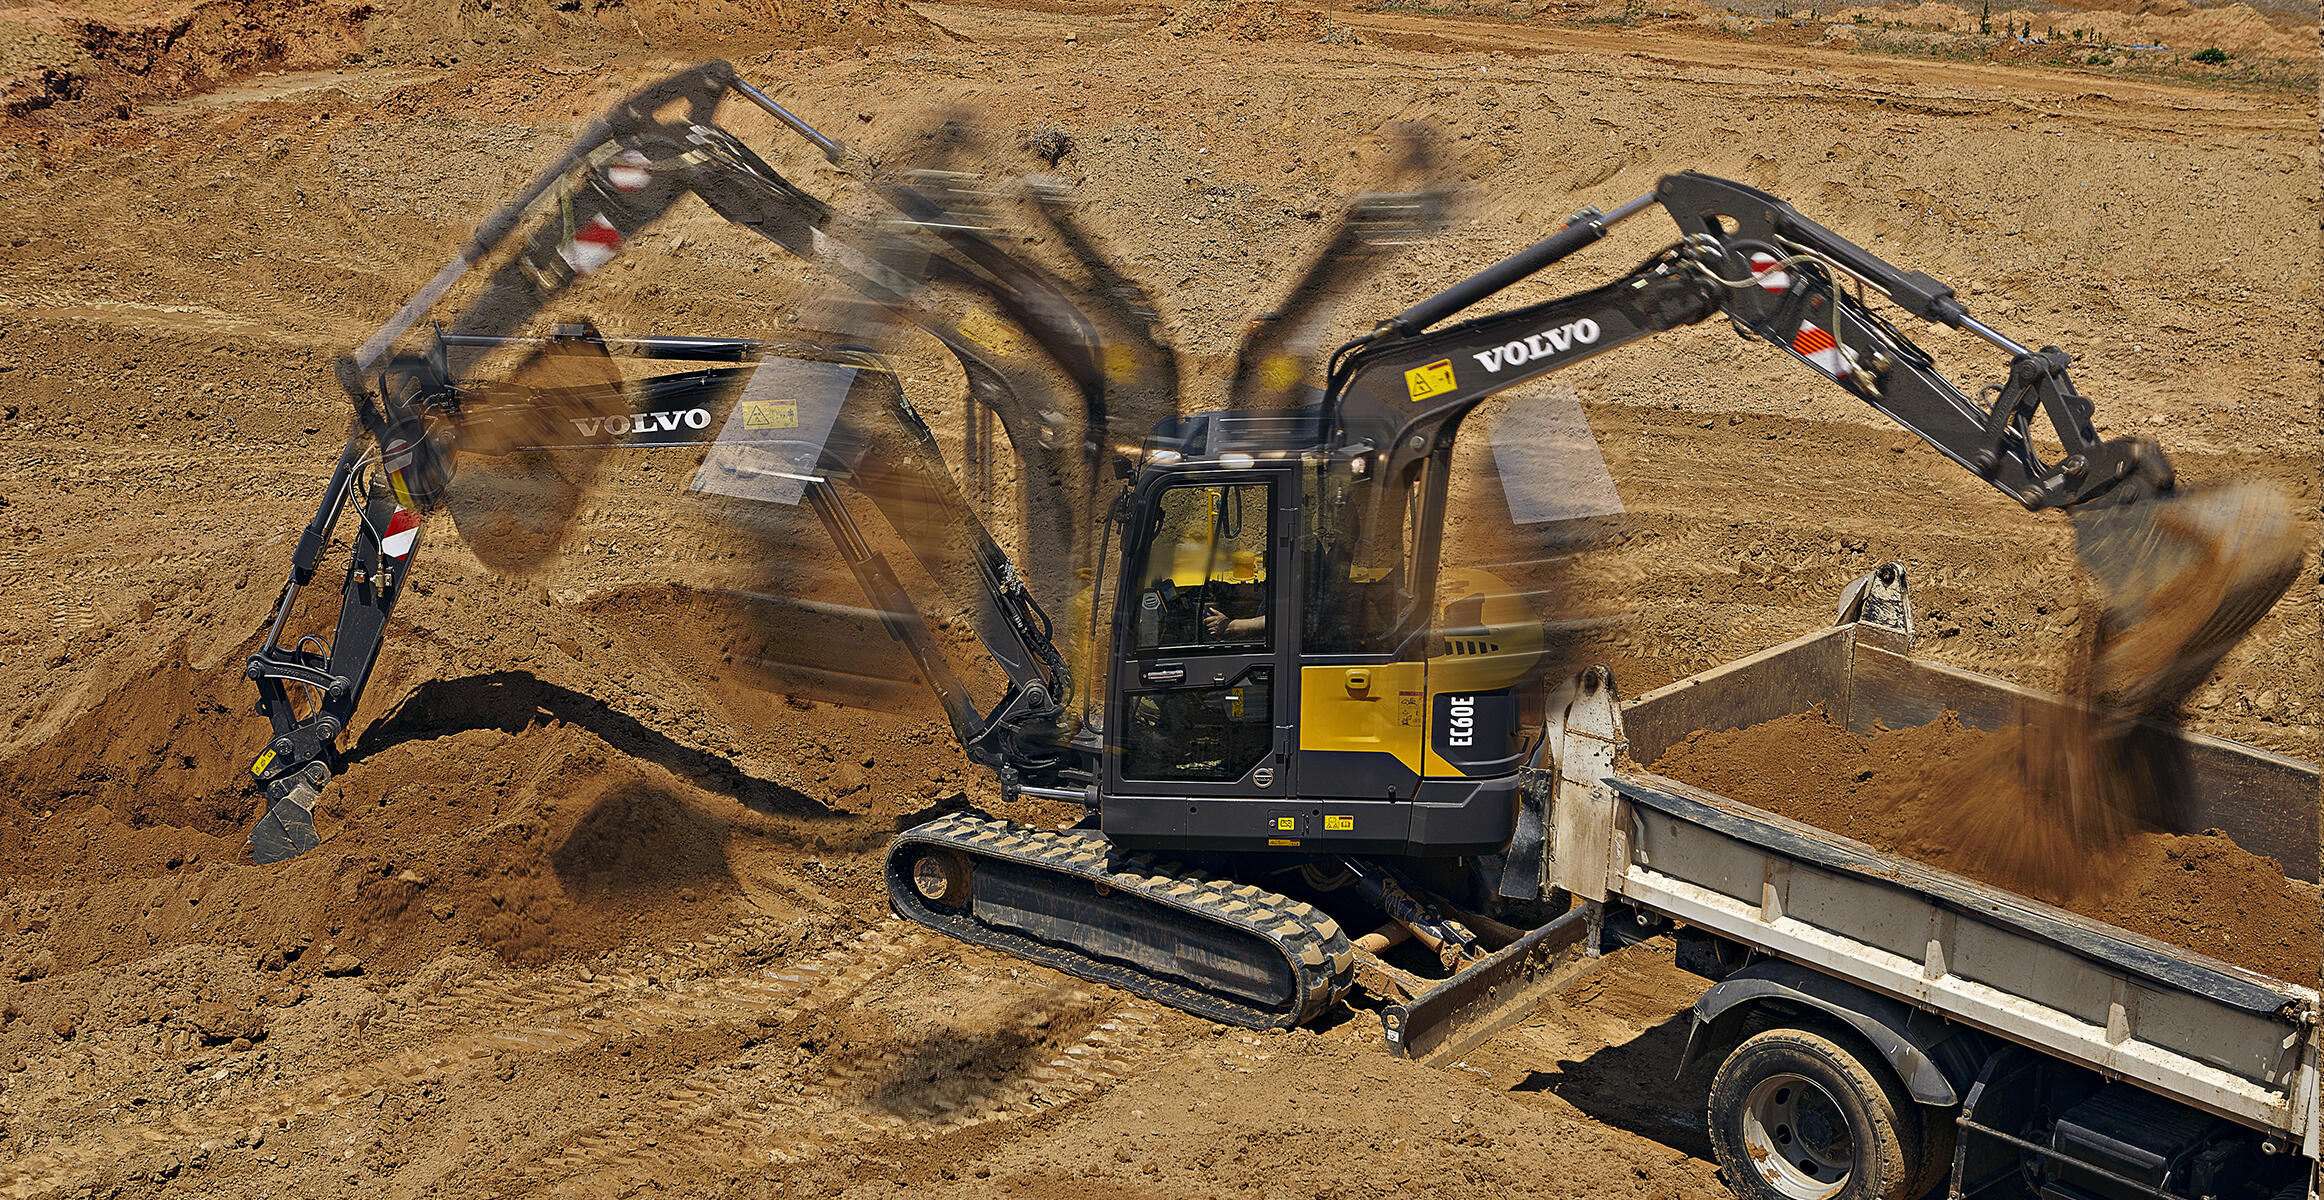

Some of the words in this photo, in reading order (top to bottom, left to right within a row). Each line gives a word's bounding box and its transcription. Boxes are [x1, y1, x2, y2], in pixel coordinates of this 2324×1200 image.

[1473, 318, 1600, 373] VOLVO
[570, 408, 711, 437] VOLVO
[1450, 696, 1474, 746] EC60E
